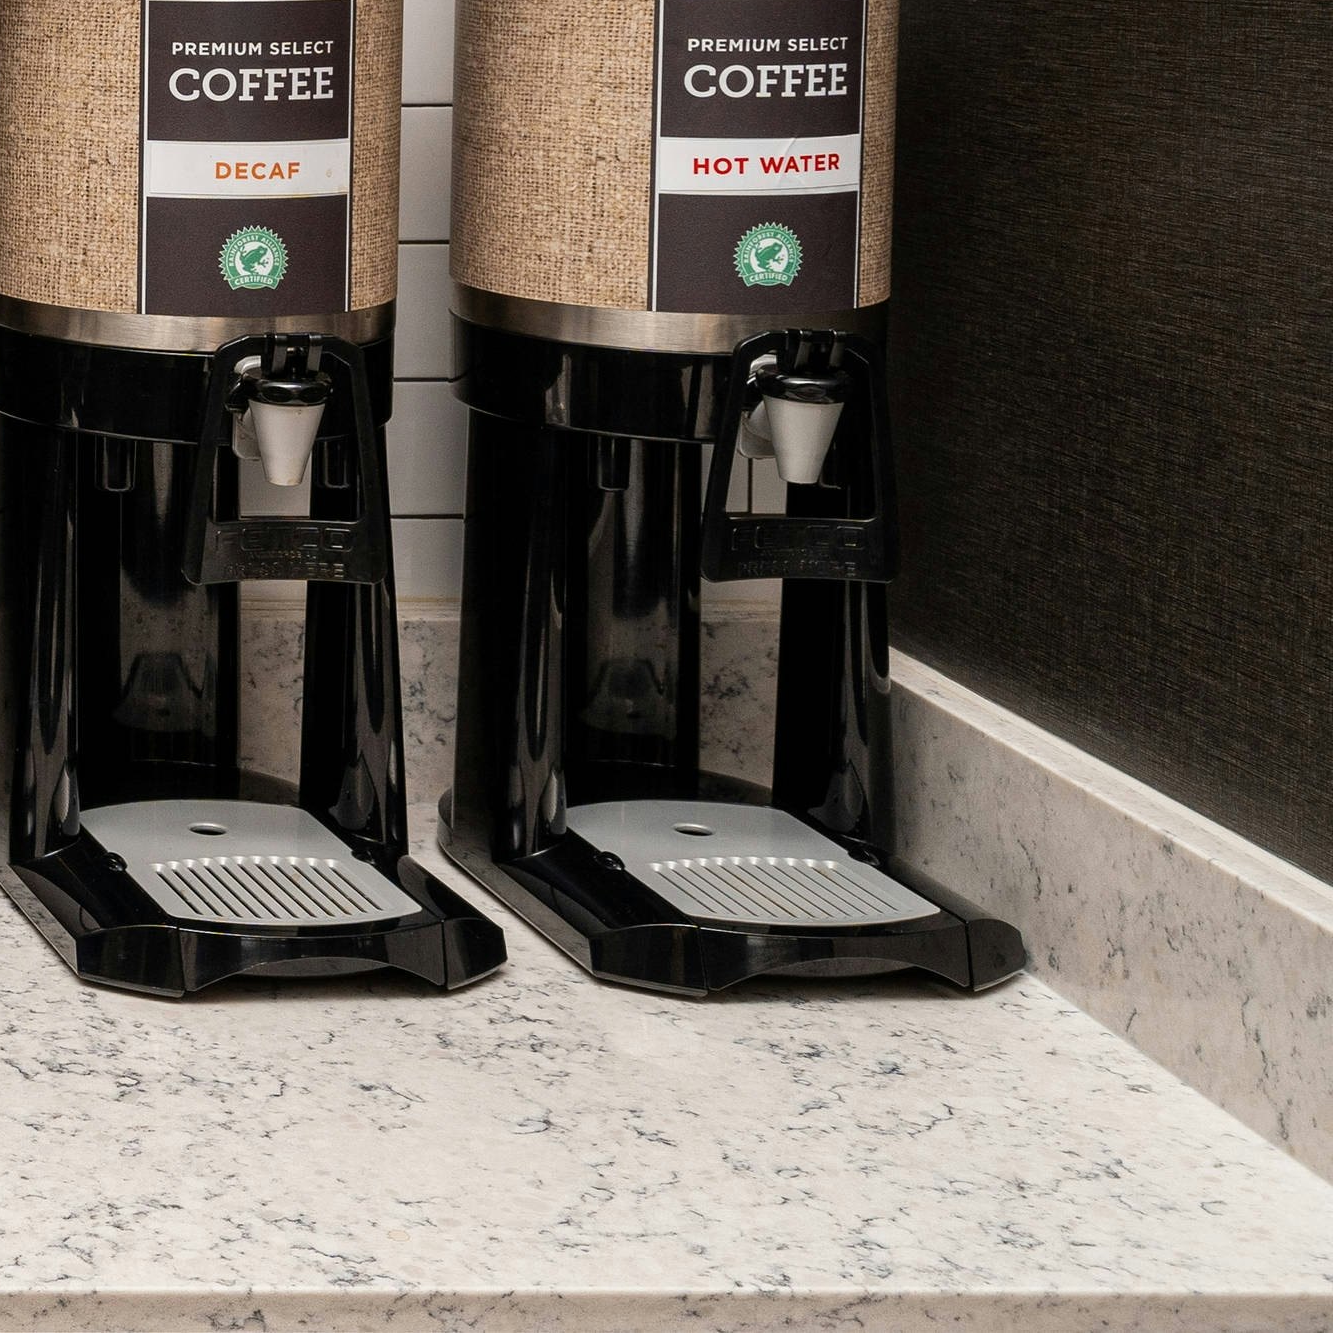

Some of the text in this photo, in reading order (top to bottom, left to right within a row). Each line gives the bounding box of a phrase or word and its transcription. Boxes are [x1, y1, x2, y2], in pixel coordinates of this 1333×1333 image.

[172, 40, 334, 56] PREMIUM SELECT
[687, 37, 848, 52] PREMIUM SELECT
[169, 66, 334, 102] COFFEE
[684, 63, 847, 98] COFFEE
[215, 162, 300, 180] DECAF
[693, 153, 840, 175] HOT WATER
[234, 276, 273, 285] CERTIFIED
[749, 273, 788, 282] CERTIFIED
